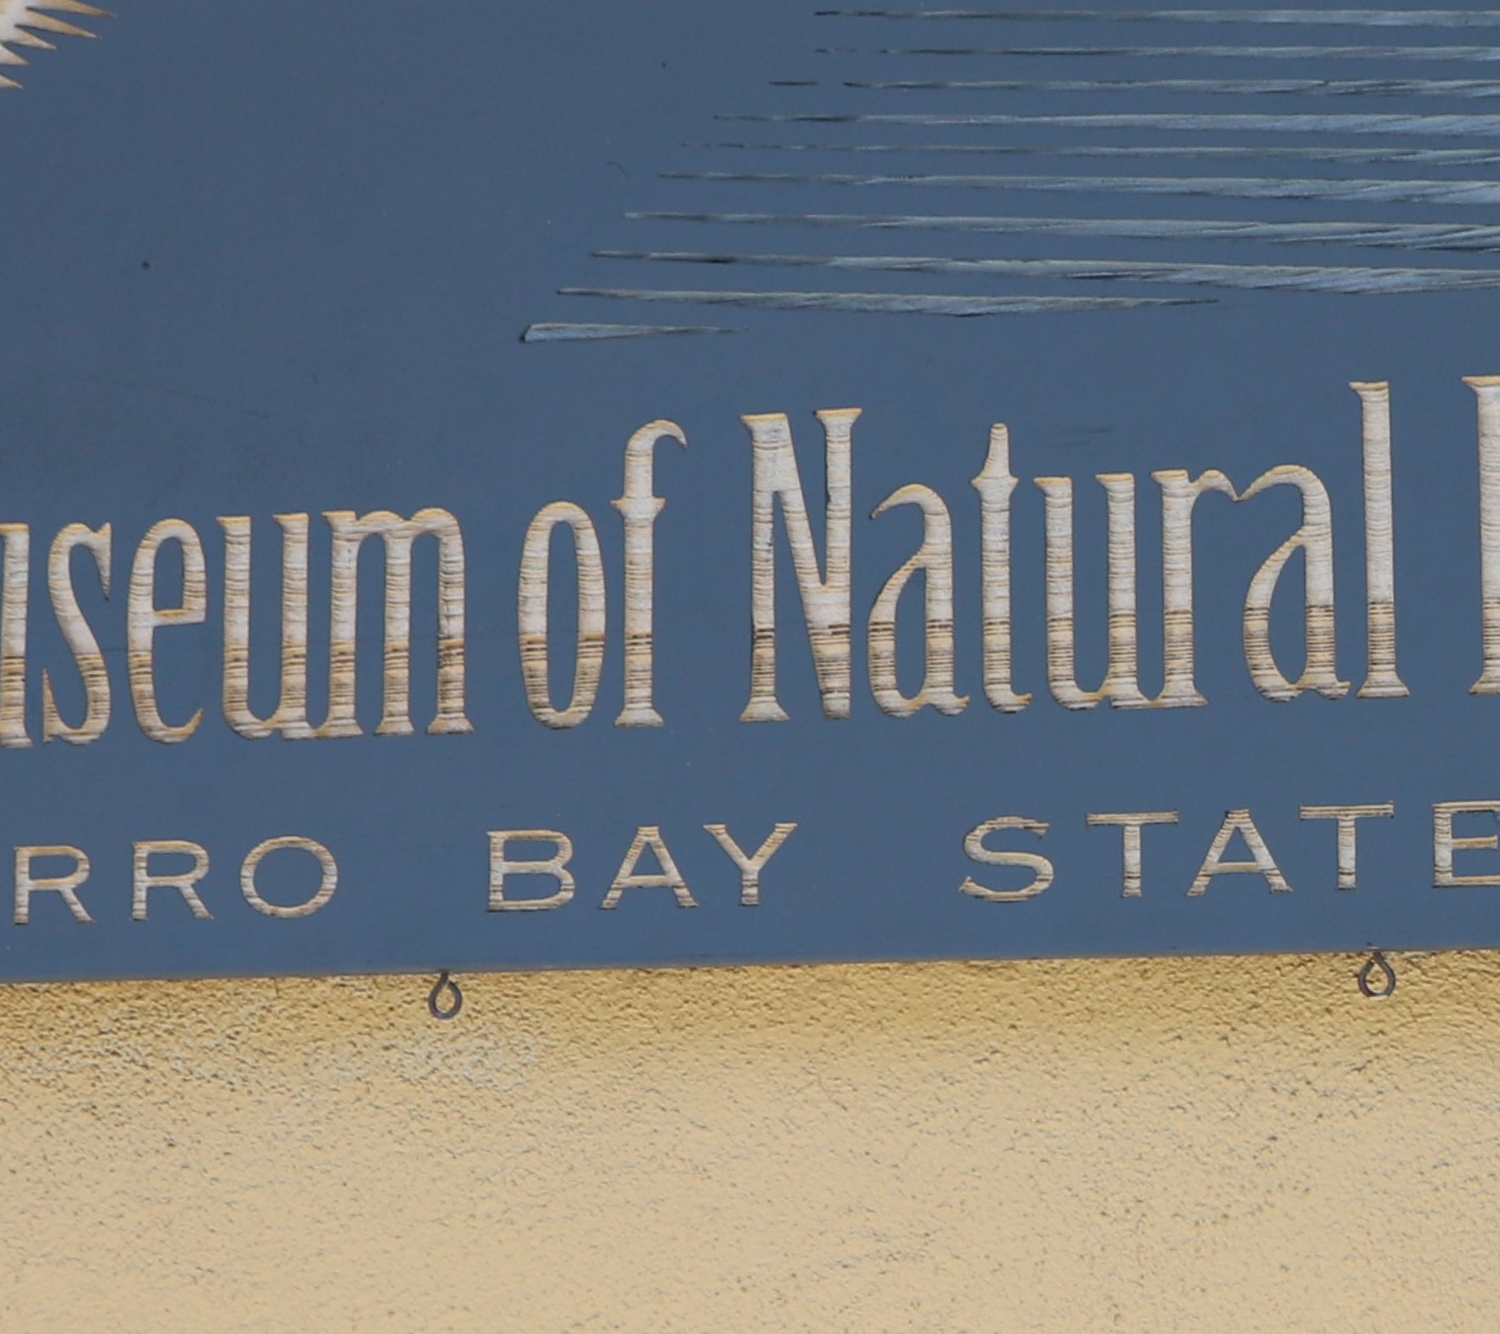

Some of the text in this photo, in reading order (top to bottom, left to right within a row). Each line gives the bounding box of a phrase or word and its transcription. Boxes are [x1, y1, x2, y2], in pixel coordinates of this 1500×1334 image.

[516, 418, 688, 731] of
[738, 380, 1411, 722] Natural
[485, 822, 798, 912] BAY
